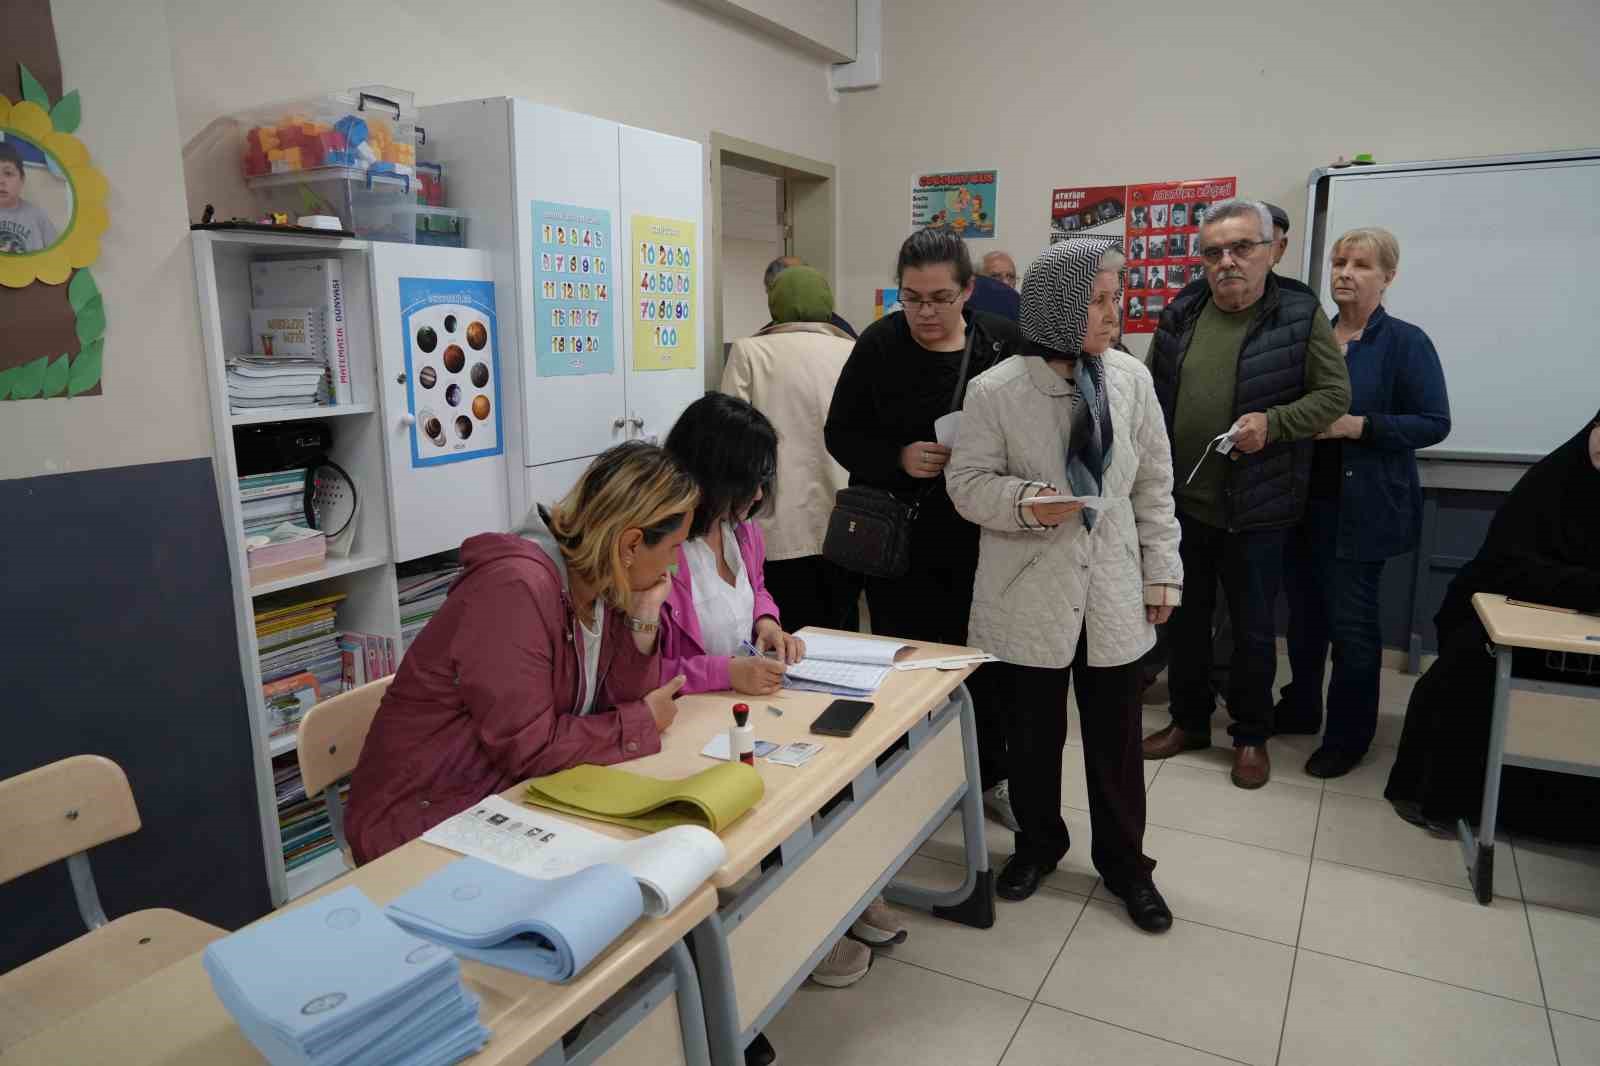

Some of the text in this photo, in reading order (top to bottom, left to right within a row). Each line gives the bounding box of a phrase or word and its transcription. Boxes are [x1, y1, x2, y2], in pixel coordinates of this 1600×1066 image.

[543, 225, 603, 248] 1 2 3 4 5
[555, 254, 564, 272] 7
[569, 255, 578, 273] 8
[581, 257, 590, 273] 9
[593, 257, 607, 274] 10
[640, 242, 690, 267] 10 20 30
[543, 281, 608, 301] 11 12 13 14
[640, 271, 656, 291] 40
[658, 272, 674, 292] 50
[552, 309, 566, 326] 15
[586, 309, 599, 326] 17
[640, 300, 689, 320] 70 80 90
[551, 335, 599, 353] 18 19 20
[654, 326, 677, 346] 100
